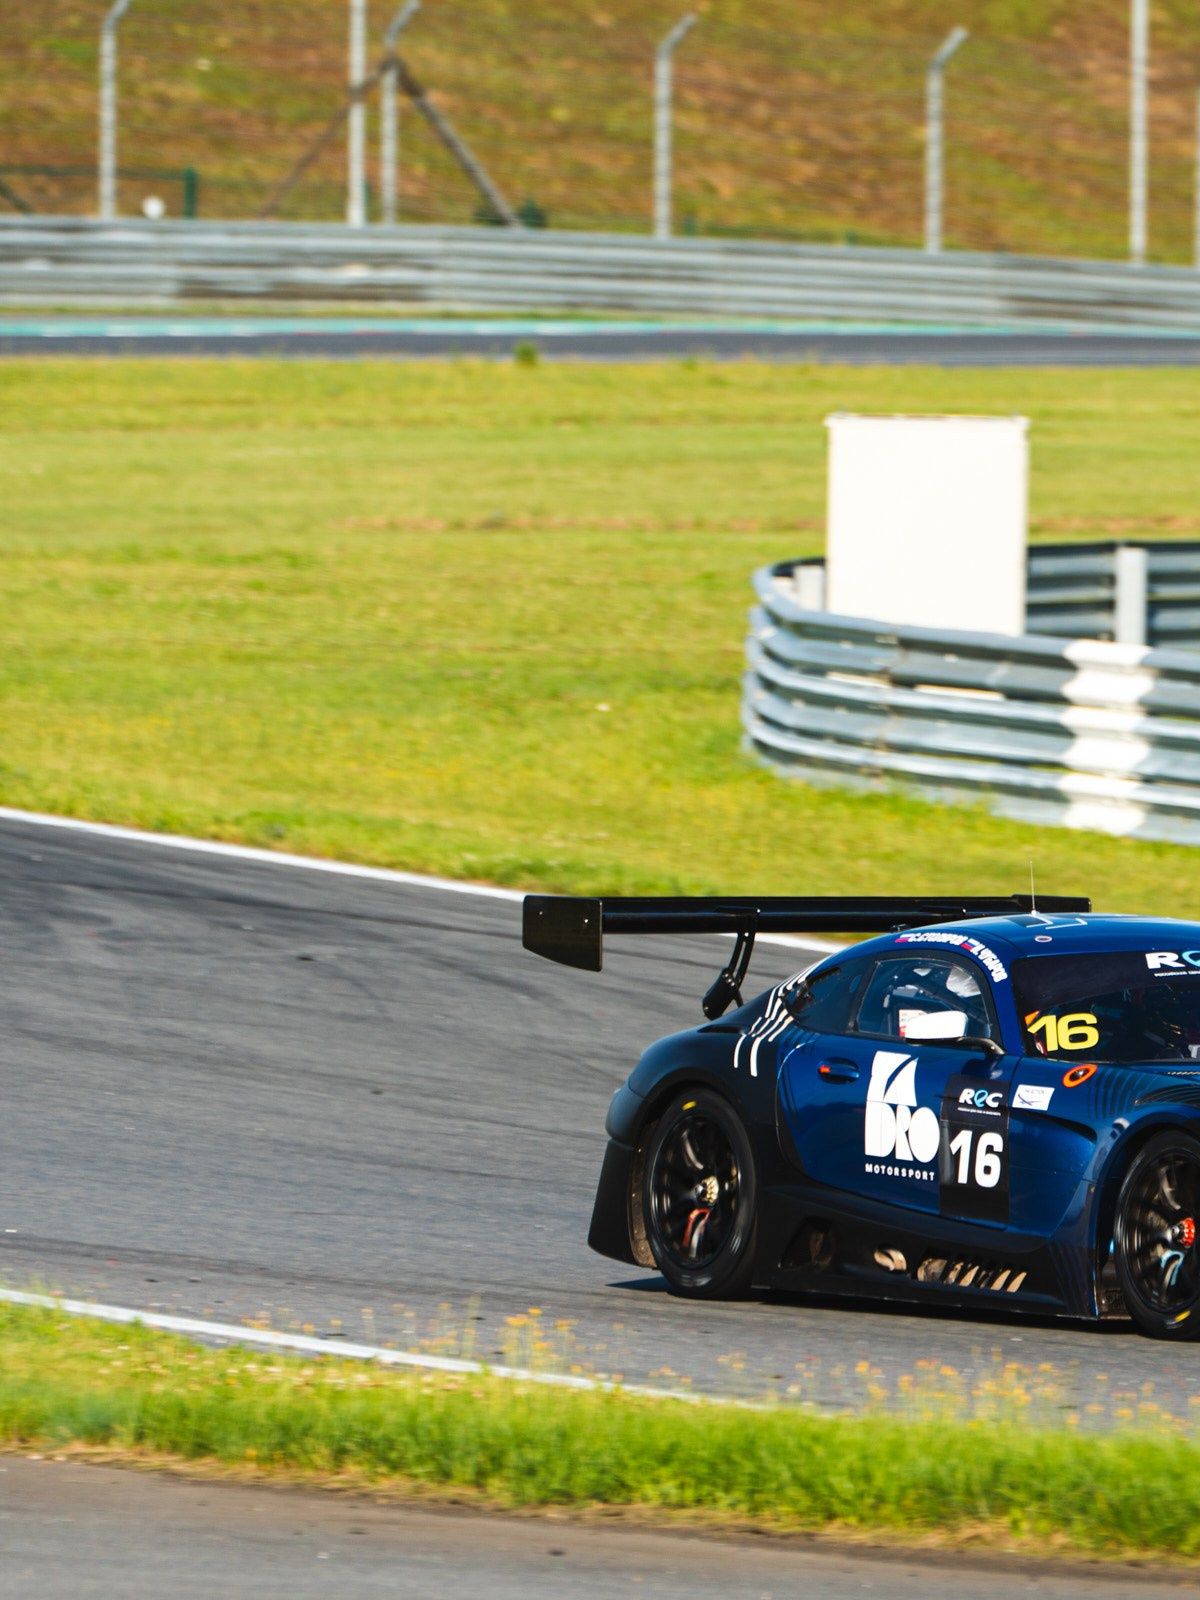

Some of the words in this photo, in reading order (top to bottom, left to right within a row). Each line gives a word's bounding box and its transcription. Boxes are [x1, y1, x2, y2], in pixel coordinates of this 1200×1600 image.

[1027, 1013, 1099, 1051] 16
[865, 1163, 935, 1181] MOTORSPORT
[949, 1130, 1004, 1188] 16
